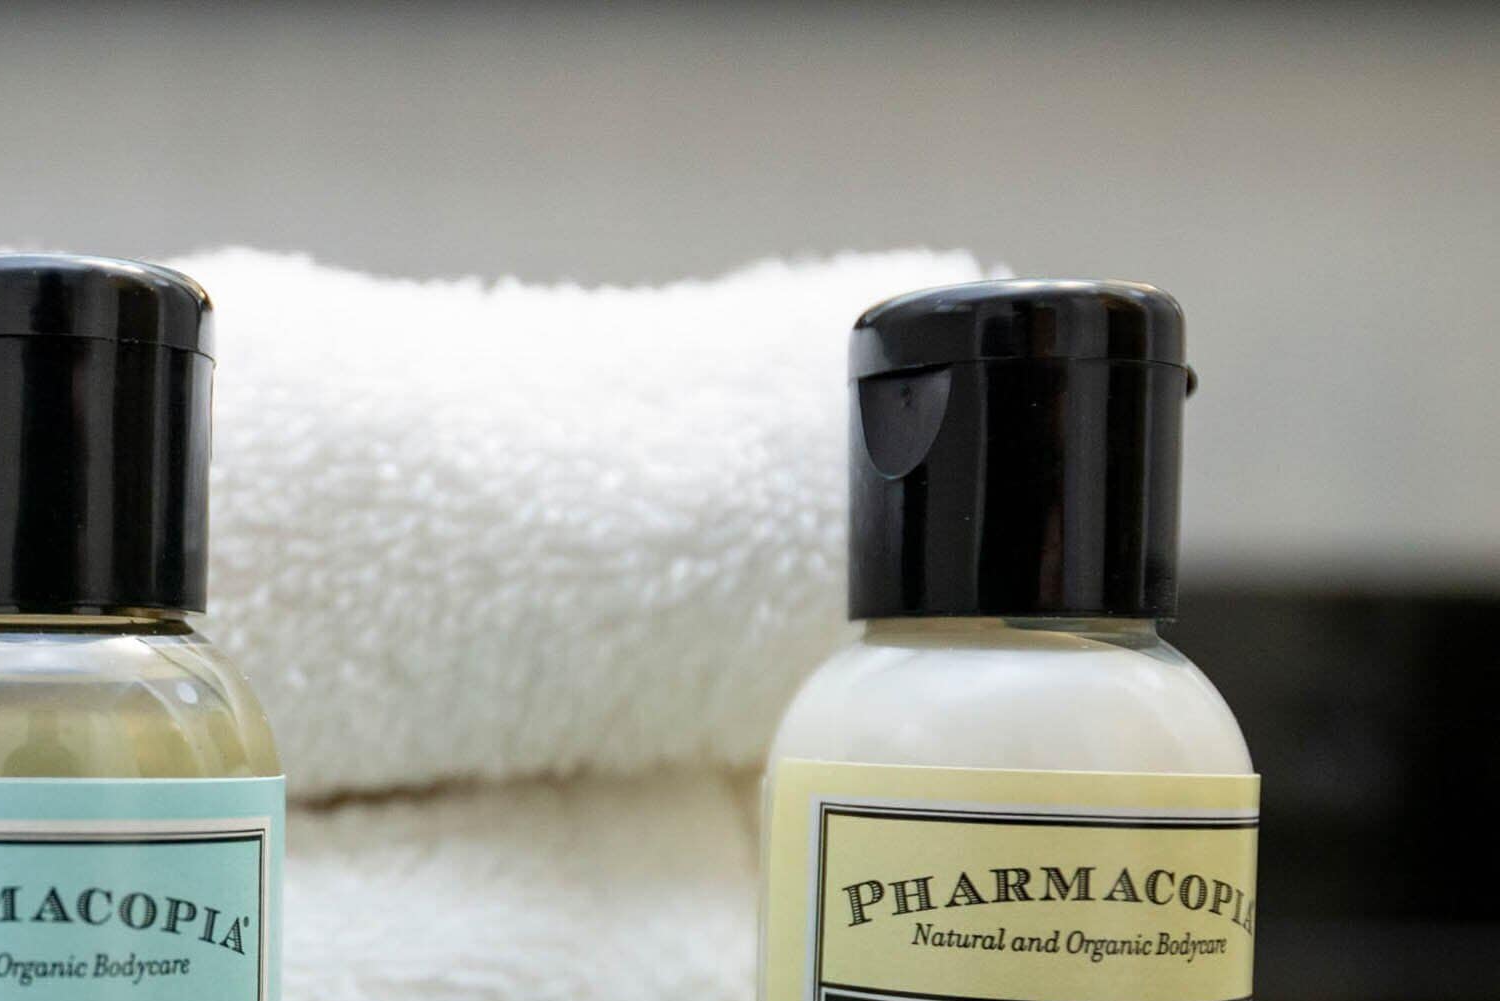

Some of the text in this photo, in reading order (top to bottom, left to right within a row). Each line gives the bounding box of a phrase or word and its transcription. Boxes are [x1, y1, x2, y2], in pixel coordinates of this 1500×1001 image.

[912, 923, 1226, 963] Natural and Organic Bodycare
[94, 952, 191, 984] Bodycare
